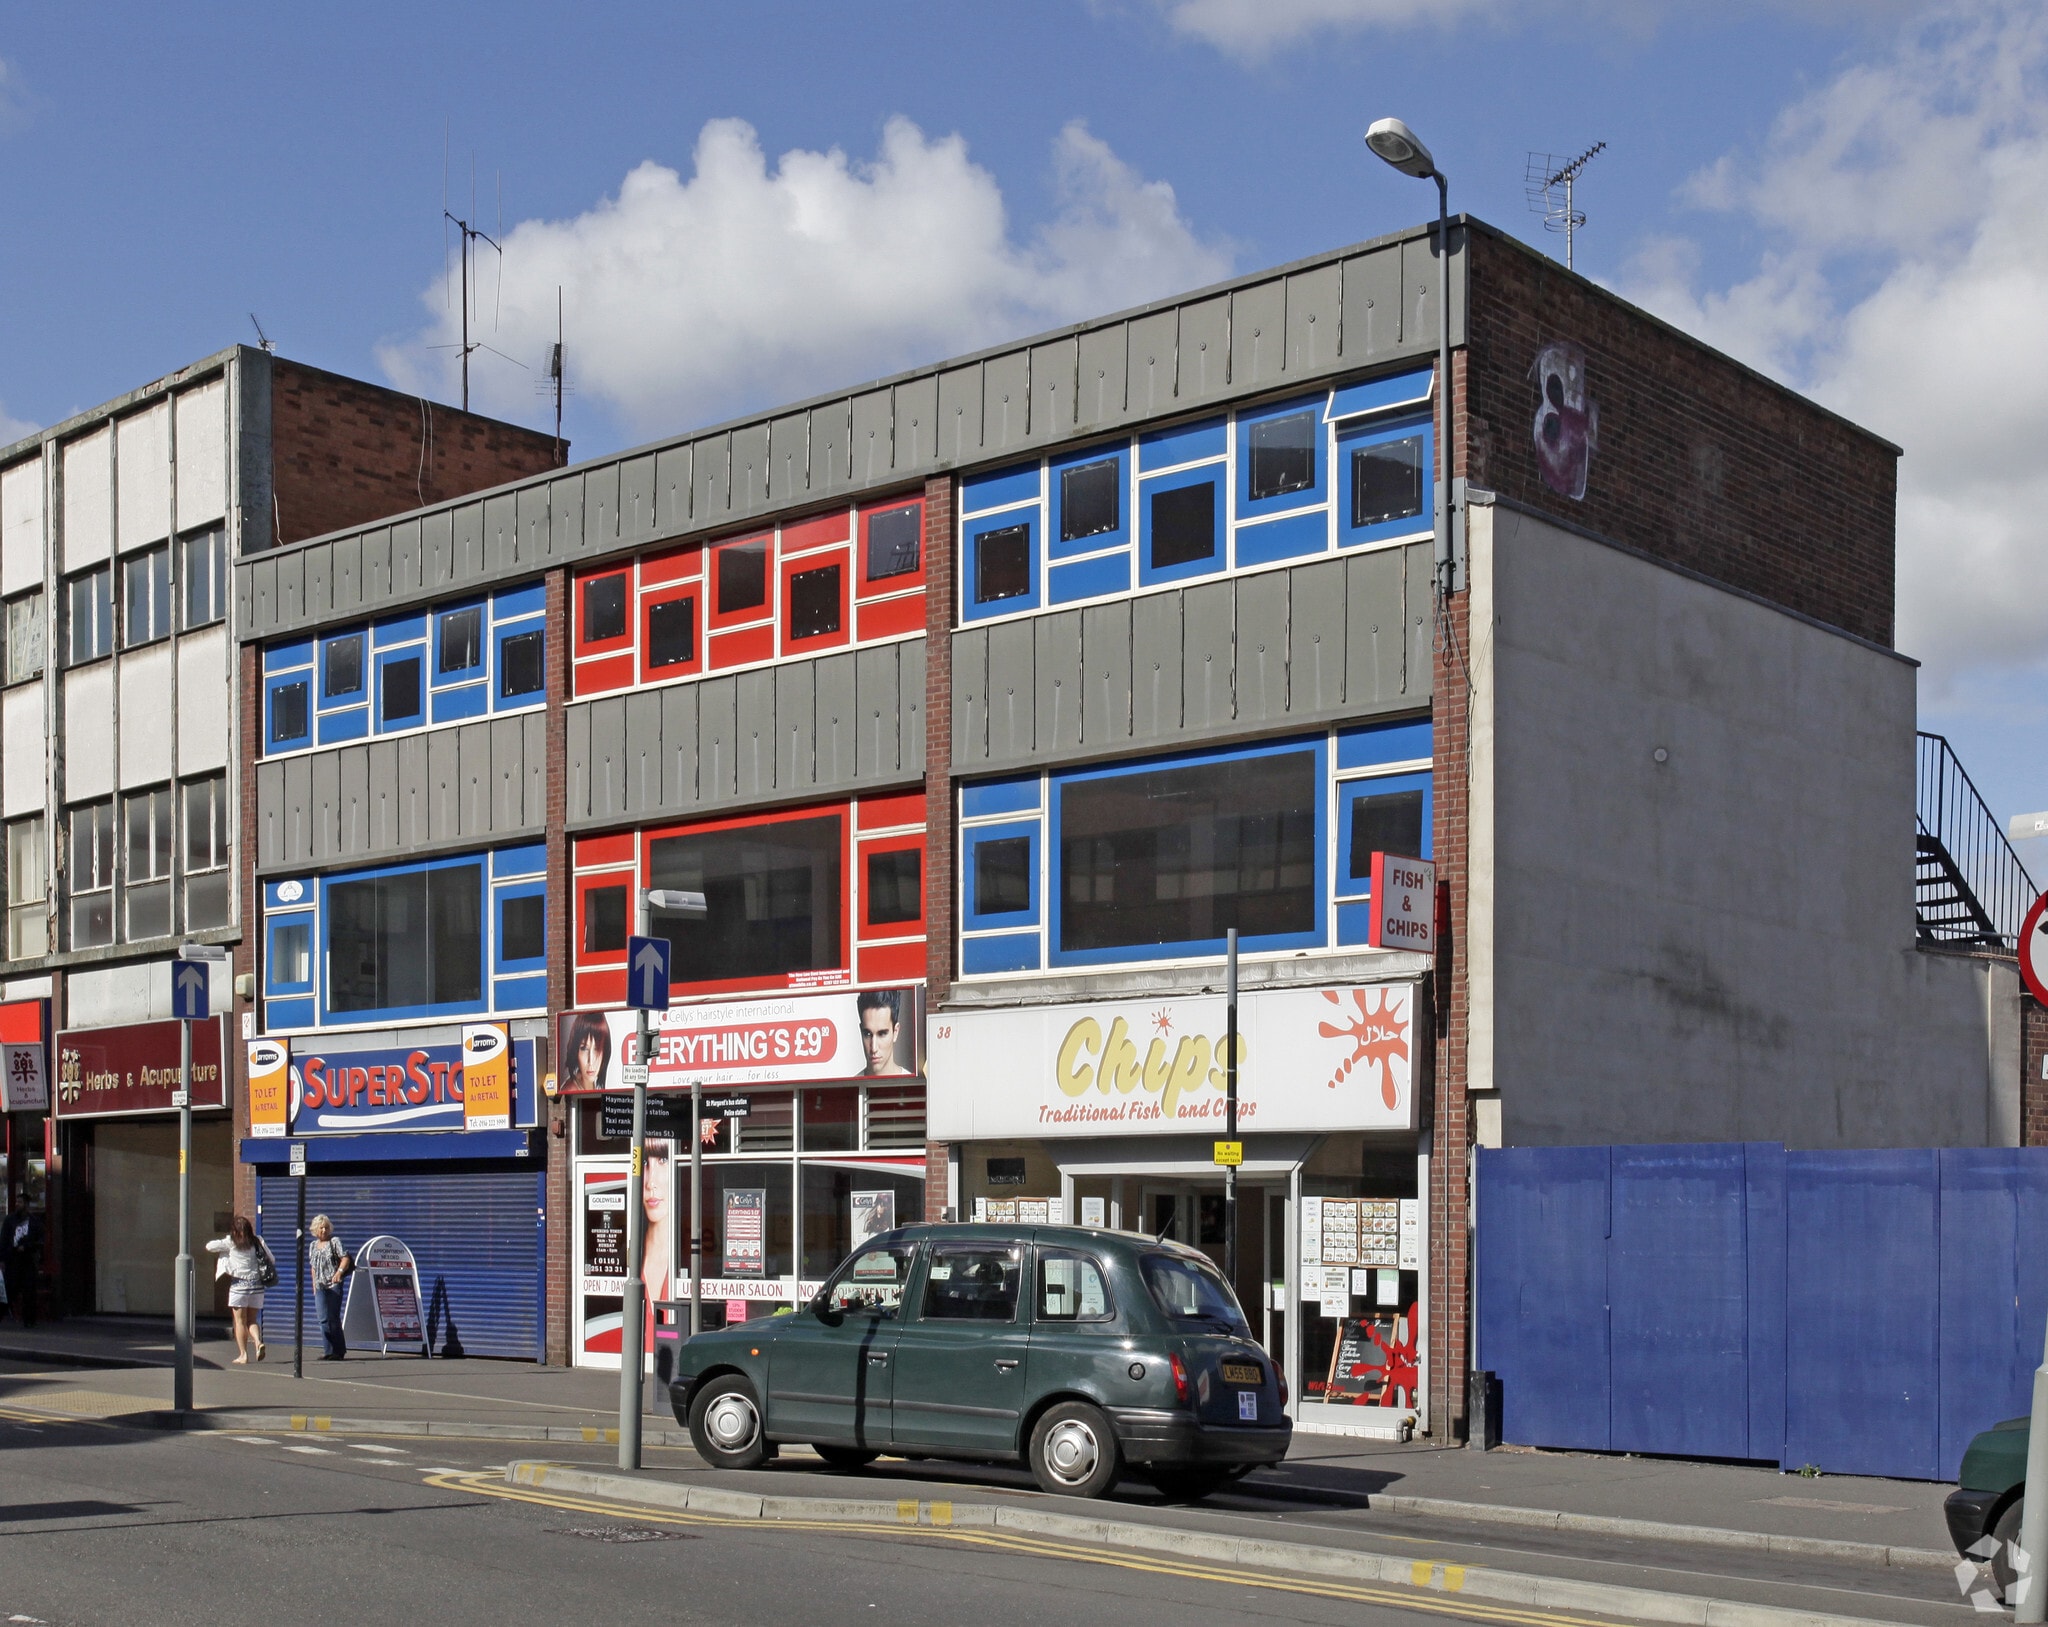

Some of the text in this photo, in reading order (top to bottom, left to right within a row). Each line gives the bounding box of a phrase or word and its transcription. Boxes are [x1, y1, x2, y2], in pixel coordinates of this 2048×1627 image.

[1393, 869, 1424, 889] FISH
[1402, 895, 1411, 912] &
[1386, 918, 1428, 939] CHIPS
[697, 1006, 734, 1022] hairstyle
[736, 1002, 795, 1018] international
[936, 1026, 952, 1040] 38
[1360, 1025, 1399, 1046] حلال
[1056, 1015, 1247, 1119] Chips
[86, 1062, 218, 1091] Herbs & Acuputure
[470, 1075, 496, 1087] TO LET
[672, 1075, 691, 1085] Love
[716, 1072, 734, 1082] hair
[748, 1070, 762, 1080] for
[764, 1070, 780, 1080] less
[254, 1088, 277, 1098] TO LET
[476, 1092, 498, 1100] RETAIL
[605, 1096, 634, 1104] Haymarke
[260, 1102, 278, 1110] RETAIL
[605, 1106, 634, 1114] Haymarke
[1038, 1102, 1126, 1123] Traditional
[1128, 1100, 1160, 1120] Fish
[1177, 1098, 1210, 1119] and
[584, 1280, 625, 1293] OPEN 7 DAY
[682, 1282, 782, 1297] USEX HAIR SALON
[800, 1284, 814, 1298] NO
